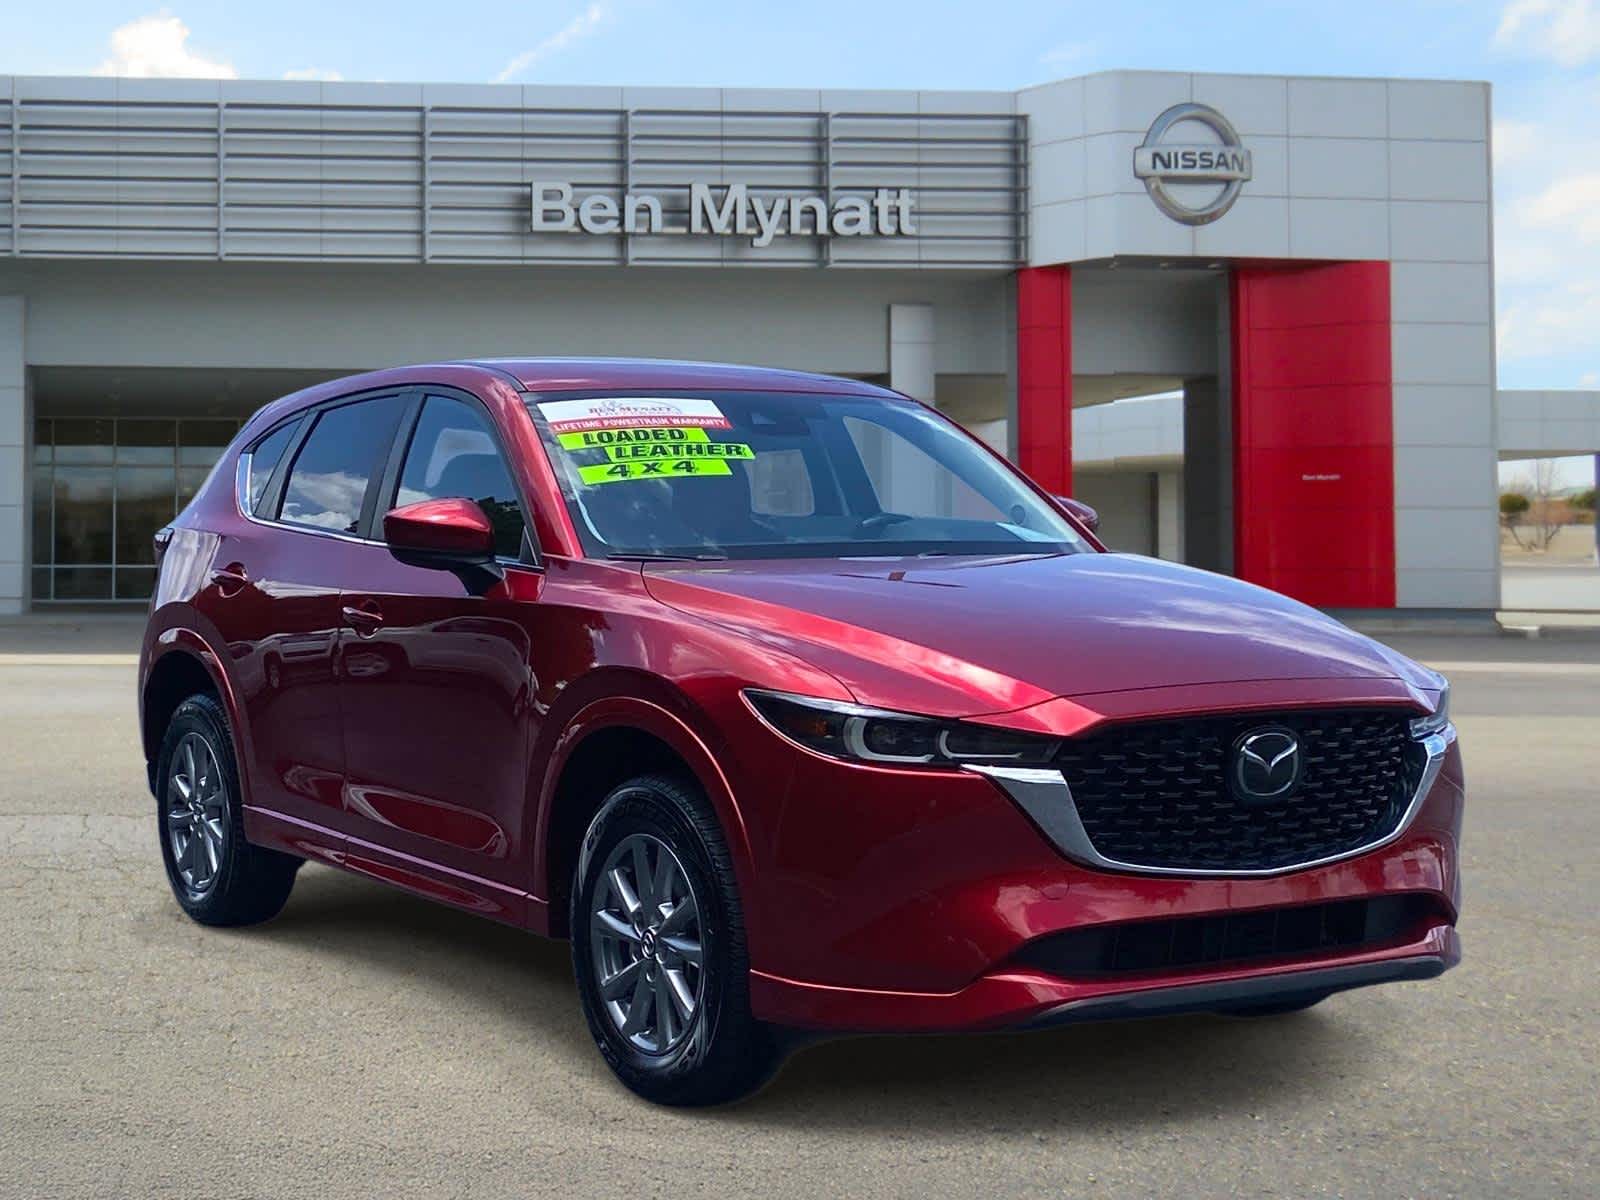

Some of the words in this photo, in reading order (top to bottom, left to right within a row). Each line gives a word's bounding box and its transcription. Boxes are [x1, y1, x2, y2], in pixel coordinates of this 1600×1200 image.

[1151, 151, 1244, 173] NISSAN
[530, 181, 663, 235] Ben
[689, 182, 917, 248] Mynatt
[553, 419, 601, 432] LIFETIME
[603, 417, 670, 427] POWERTRAIN
[671, 417, 726, 427] WARRANTY
[582, 428, 688, 445] LOADED
[615, 443, 743, 459] LEATHER
